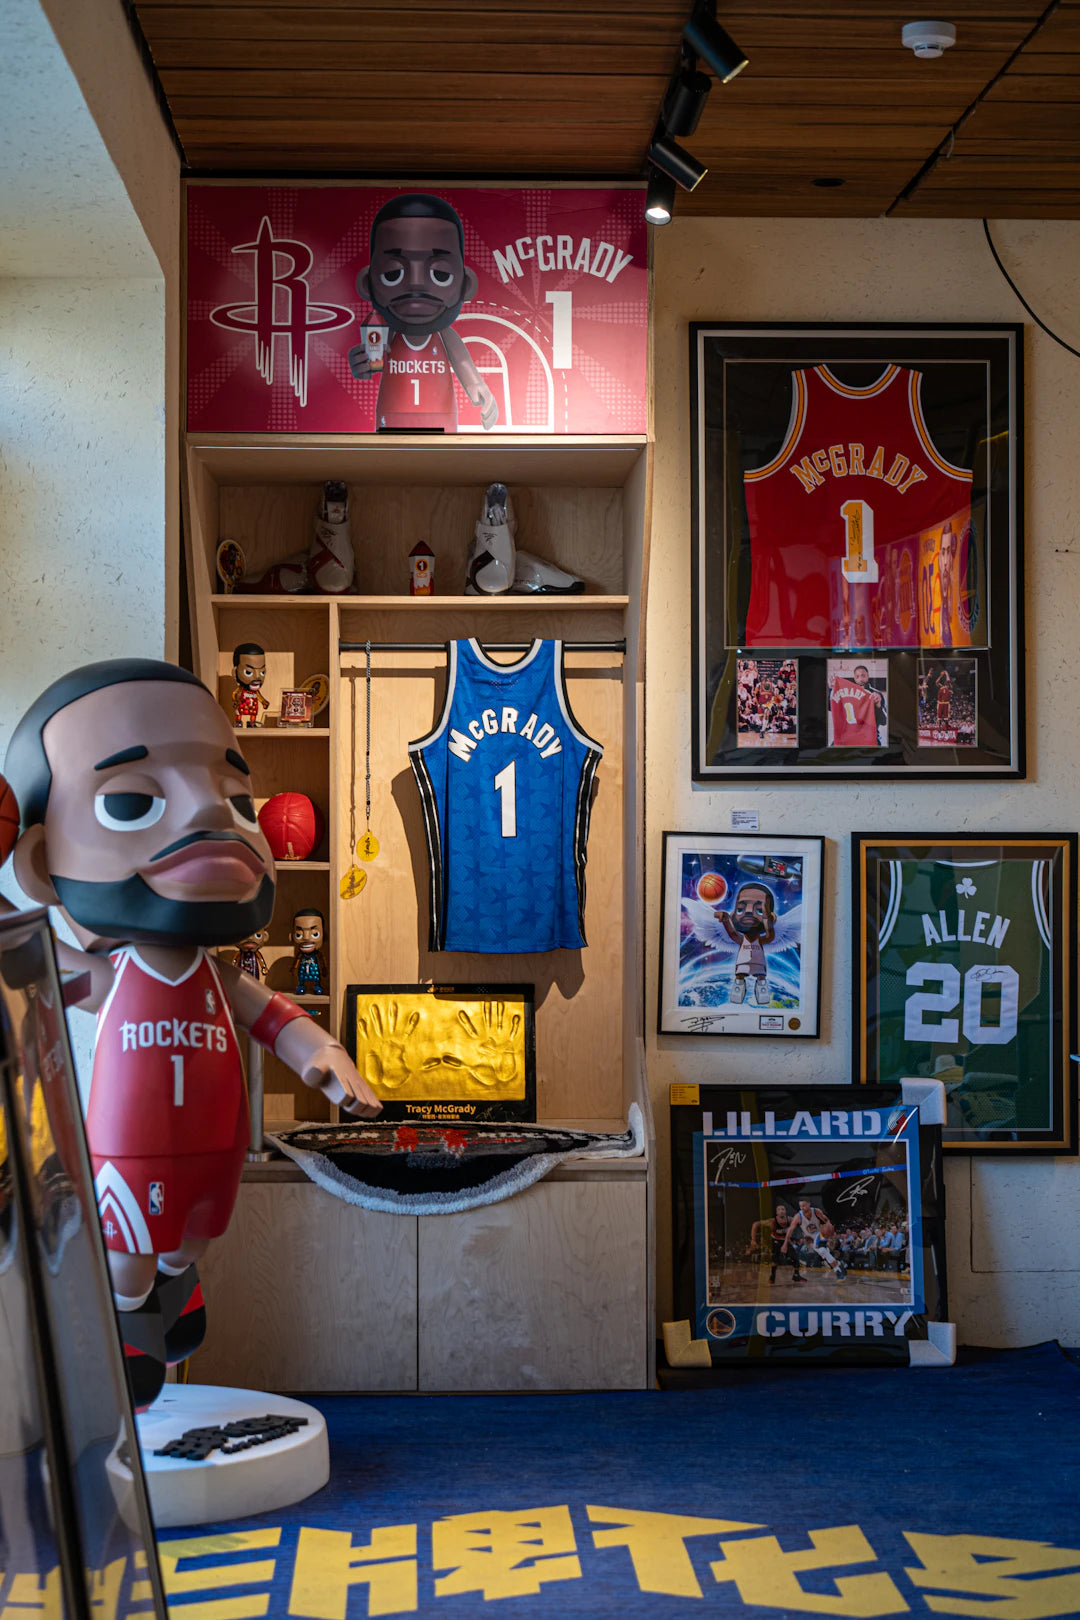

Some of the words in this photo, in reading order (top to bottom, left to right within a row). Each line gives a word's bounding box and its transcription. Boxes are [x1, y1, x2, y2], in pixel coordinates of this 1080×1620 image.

[545, 290, 572, 369] 1
[388, 358, 446, 374] ROCKETS
[410, 379, 420, 406] 1
[840, 499, 878, 583] 1
[843, 702, 857, 724] 1
[494, 759, 517, 838] 1
[921, 909, 1011, 949] ALLEN
[904, 961, 1019, 1045] 20
[119, 1018, 227, 1053] ROCKETS
[170, 1055, 184, 1107] 1
[405, 1104, 432, 1115] Tracy
[434, 1104, 477, 1115] McGrady
[702, 1110, 881, 1137] LILLARD
[756, 1310, 914, 1337] CURRY
